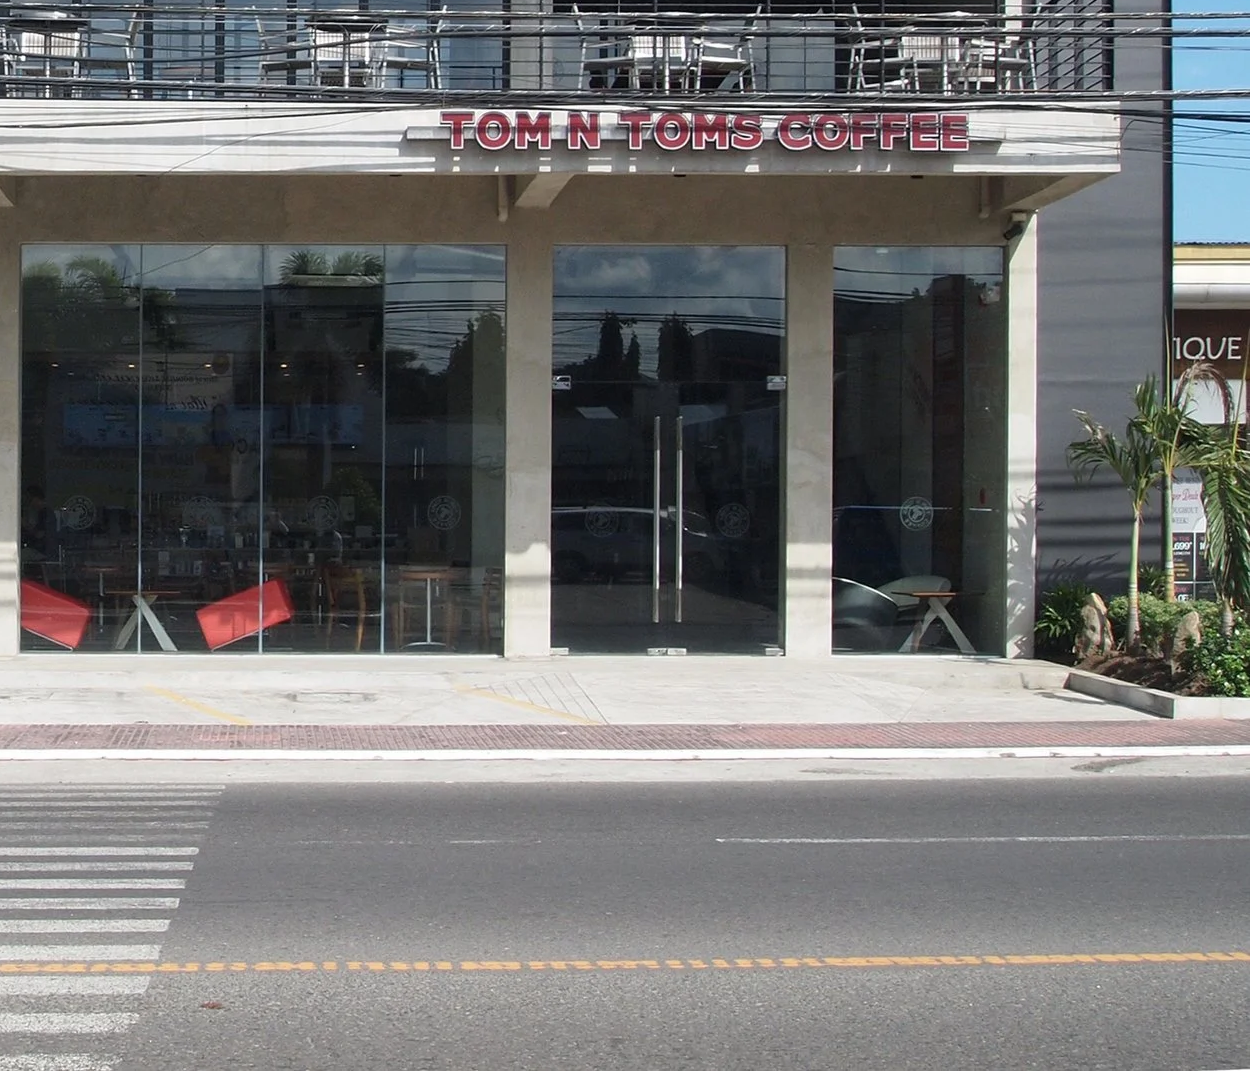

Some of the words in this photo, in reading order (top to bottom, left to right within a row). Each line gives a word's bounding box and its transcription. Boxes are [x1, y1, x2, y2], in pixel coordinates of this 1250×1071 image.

[440, 111, 551, 150] TOM
[566, 112, 601, 150] N
[619, 112, 764, 151] TOMS
[777, 113, 970, 151] COFFEE
